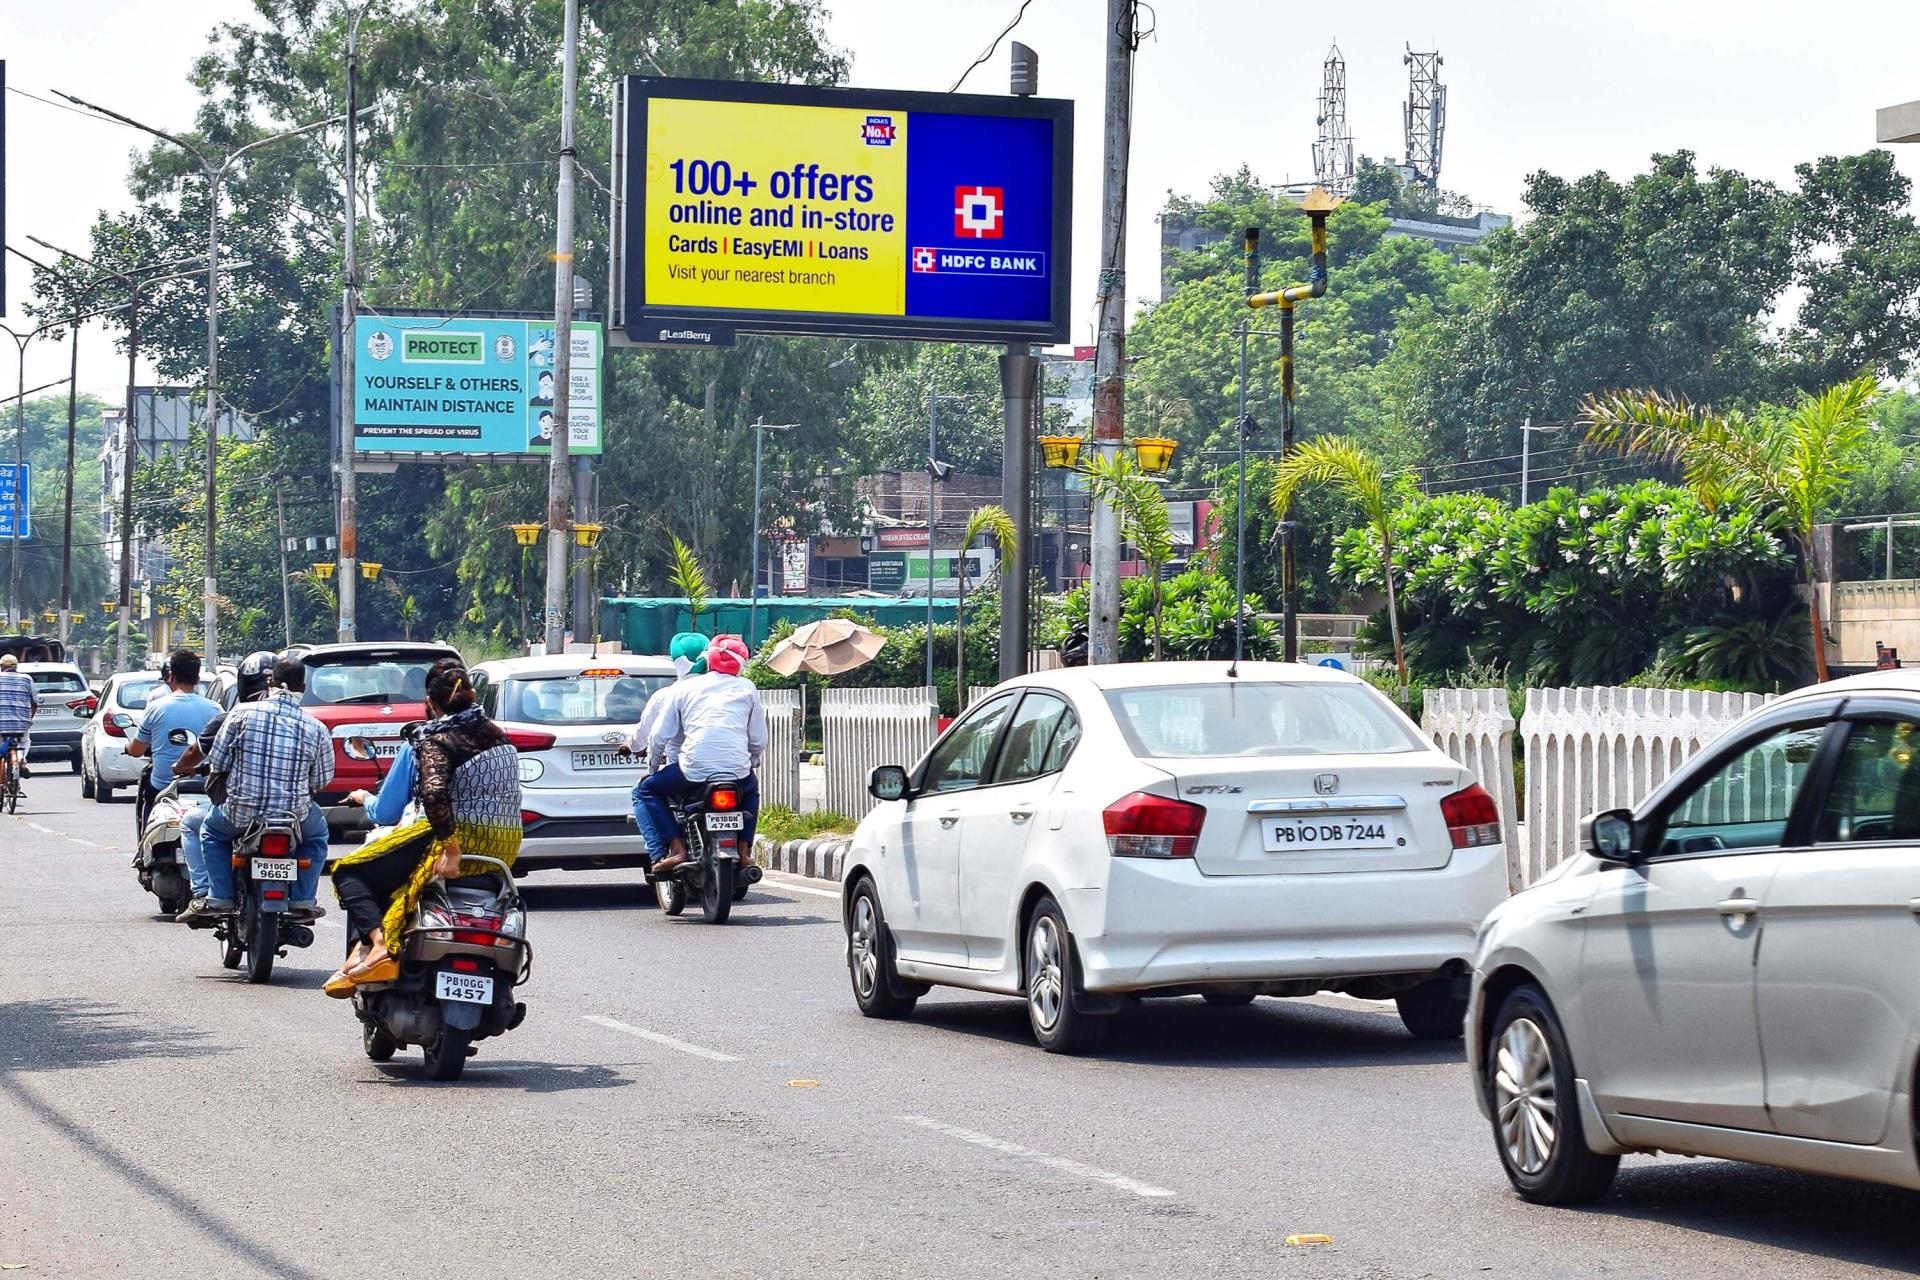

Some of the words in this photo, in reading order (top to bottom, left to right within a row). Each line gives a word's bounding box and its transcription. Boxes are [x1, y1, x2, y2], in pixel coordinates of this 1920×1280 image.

[866, 125, 890, 138] No.1
[669, 158, 757, 197] 100+
[770, 163, 874, 202] offers
[669, 200, 742, 226] online
[749, 204, 793, 228] and
[801, 205, 894, 232] in-store
[668, 234, 718, 254] Cards
[733, 237, 803, 260] EasyEMI
[818, 241, 869, 260] Loans
[941, 254, 986, 269] HDFC
[990, 256, 1037, 271] BANK
[668, 264, 697, 280] Visit
[701, 267, 730, 283] your
[735, 267, 785, 283] nearest
[789, 268, 835, 285] branch
[667, 329, 711, 342] LeafBerry
[408, 340, 478, 355] PROTECT
[364, 376, 443, 390] YOURSELF
[445, 377, 456, 391] &
[460, 378, 523, 393] OTHERS,
[364, 398, 438, 412] MAINTAIN
[442, 399, 515, 414] DISTANCE
[363, 427, 397, 435] PREVENT
[414, 428, 444, 436] SPREAD
[445, 428, 456, 436] OF
[581, 753, 647, 766] PB10HE632
[257, 862, 291, 871] PB10GC
[260, 870, 289, 879] 9663
[446, 976, 484, 989] PB10GG
[443, 986, 486, 1001] 1457
